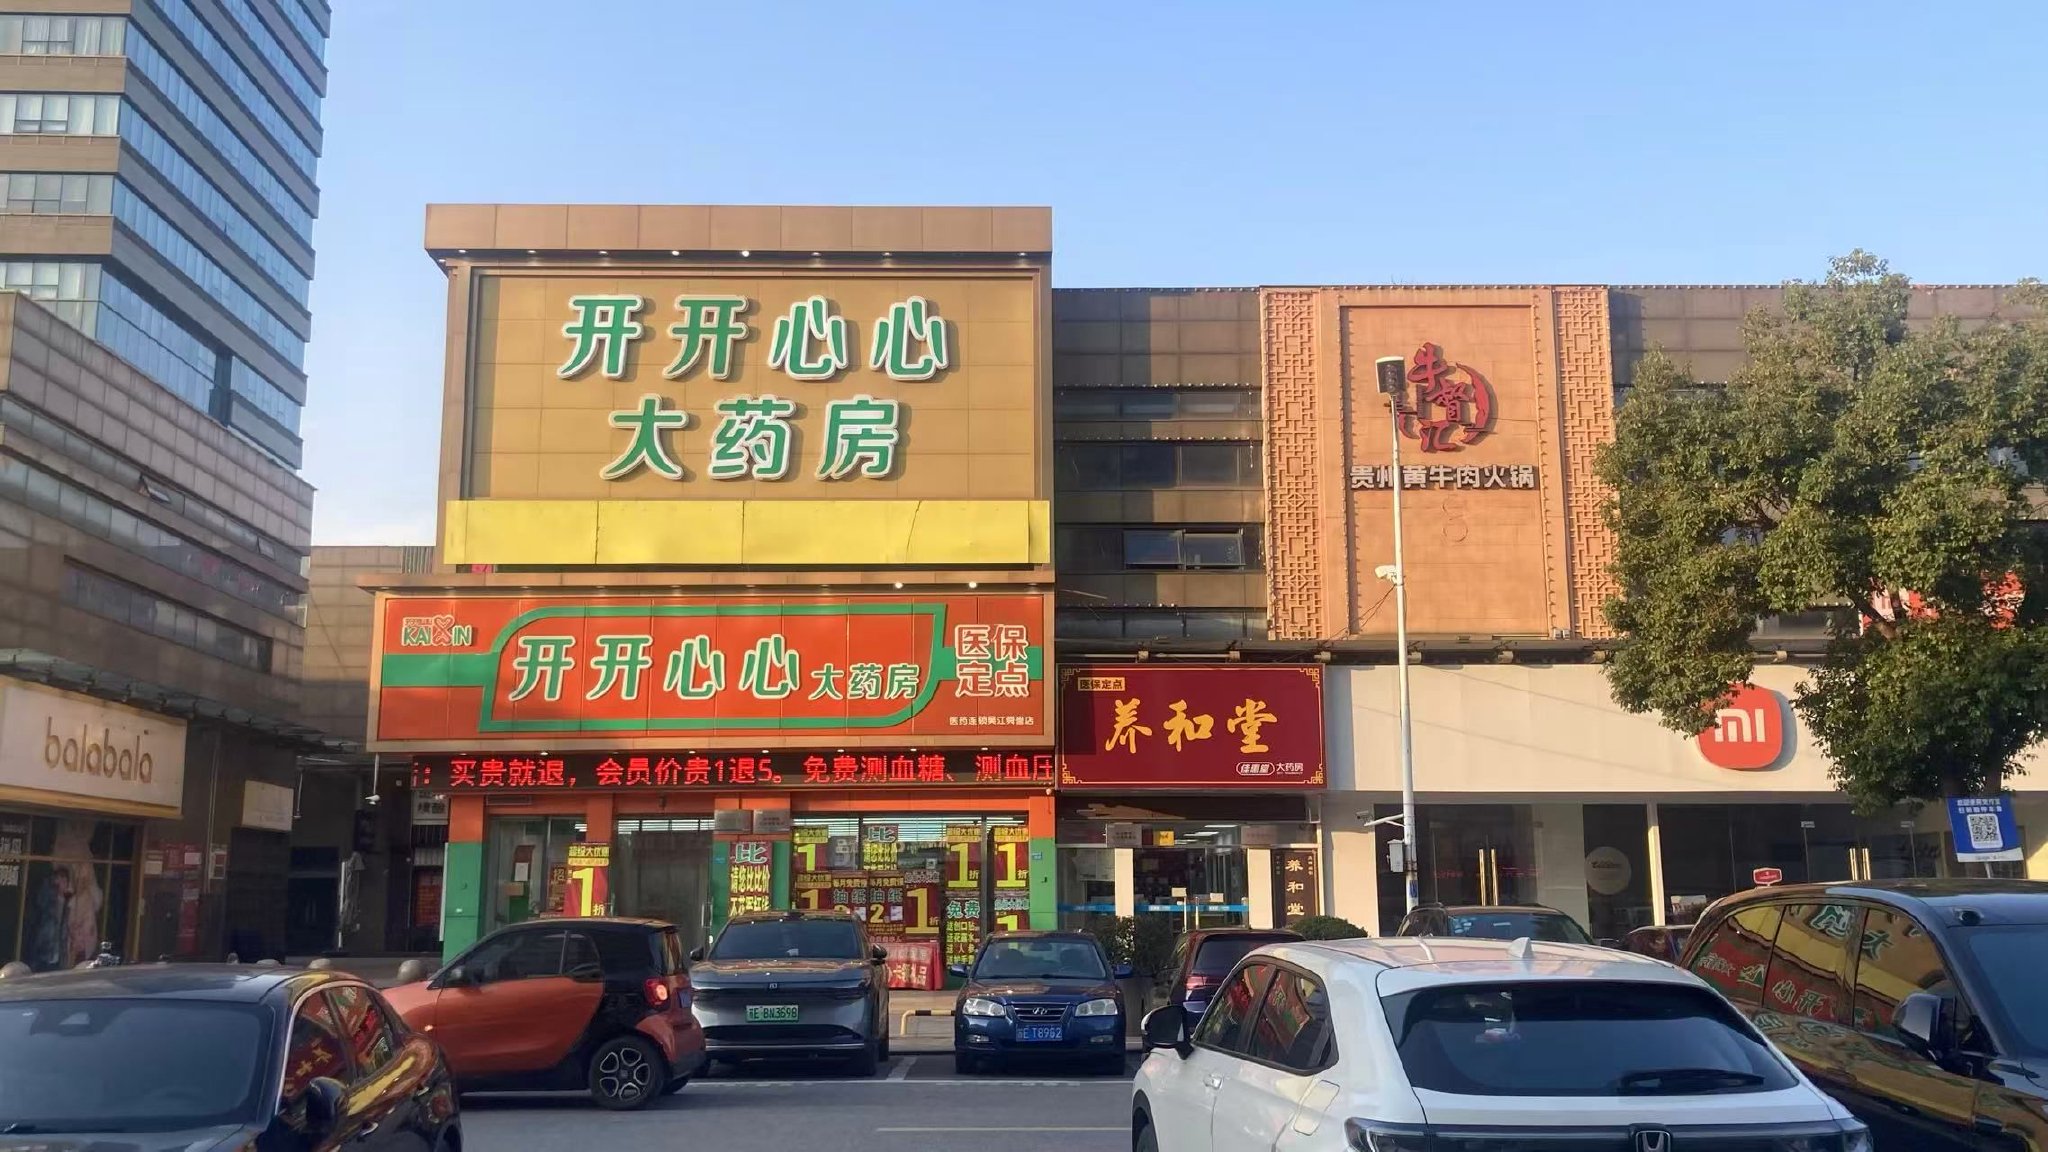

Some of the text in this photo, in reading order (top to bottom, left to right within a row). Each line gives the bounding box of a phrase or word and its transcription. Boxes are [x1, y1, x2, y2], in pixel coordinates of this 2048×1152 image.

[557, 294, 949, 380] 开开心心
[599, 393, 899, 481] 大药房
[1350, 464, 1534, 489] 贵州黄牛肉火锅
[1079, 678, 1124, 690] 医保定点
[45, 716, 153, 784] balabala
[1105, 698, 1277, 754] 养和堂
